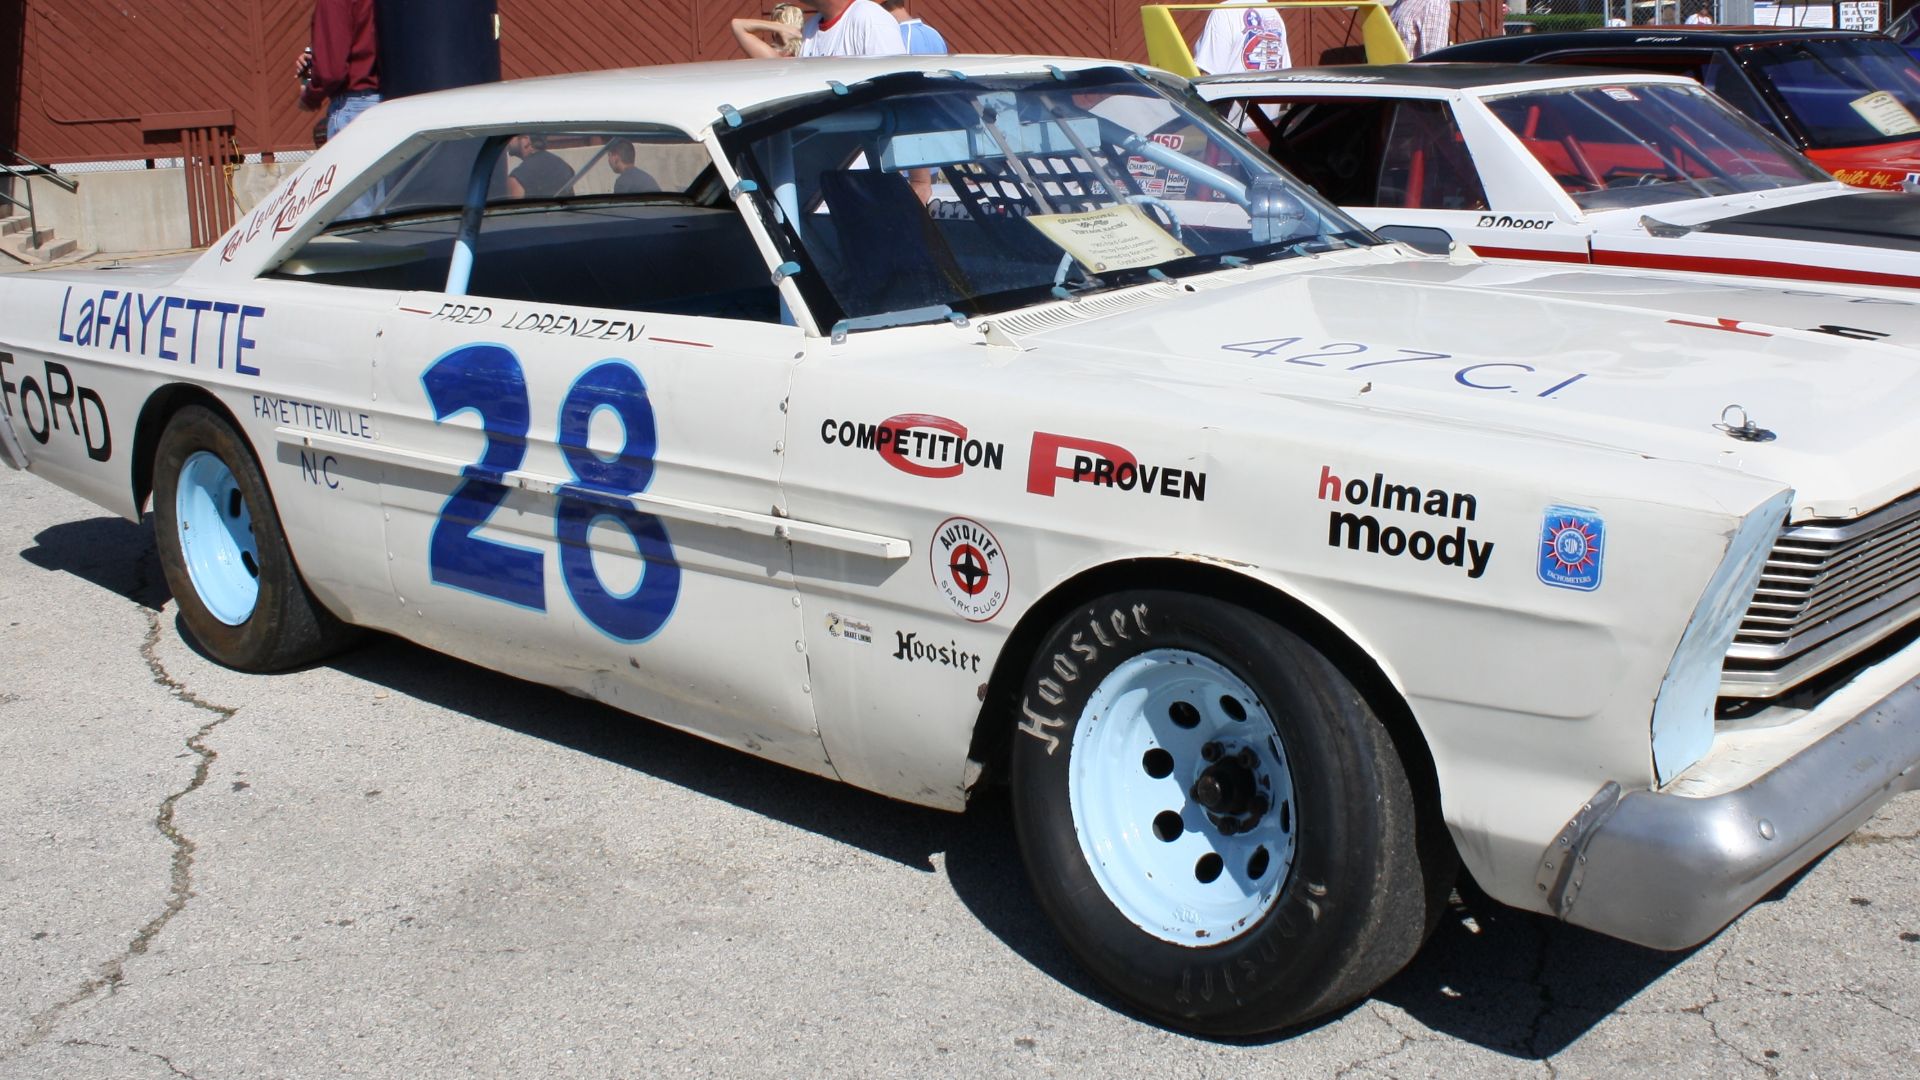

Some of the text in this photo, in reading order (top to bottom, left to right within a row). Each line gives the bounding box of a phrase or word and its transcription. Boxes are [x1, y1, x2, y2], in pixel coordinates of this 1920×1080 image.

[1128, 162, 1156, 171] CHAMPION
[1168, 173, 1188, 184] Holley
[271, 164, 337, 241] Racing
[1495, 215, 1554, 230] Mopar
[58, 286, 266, 377] LaFAYETTE
[430, 302, 645, 342] FRED LORENZEN
[1221, 337, 1452, 371] 427
[0, 352, 112, 463] FORD
[253, 395, 372, 439] FAYETTEVILLE
[821, 418, 1004, 471] COMPETITION
[300, 449, 344, 491] N.C.
[1073, 454, 1207, 502] PROVEN
[420, 341, 684, 645] 28
[1318, 465, 1477, 521] holman
[940, 525, 998, 561] AUTOLITE
[1328, 511, 1494, 578] moody
[1564, 538, 1579, 554] SUN
[941, 580, 1001, 614] SPARK PLUGS
[1546, 570, 1592, 583] TACHOMETERS
[843, 629, 858, 640] BRAKE
[893, 629, 981, 674] Hoosier
[1018, 603, 1150, 755] Hoosier
